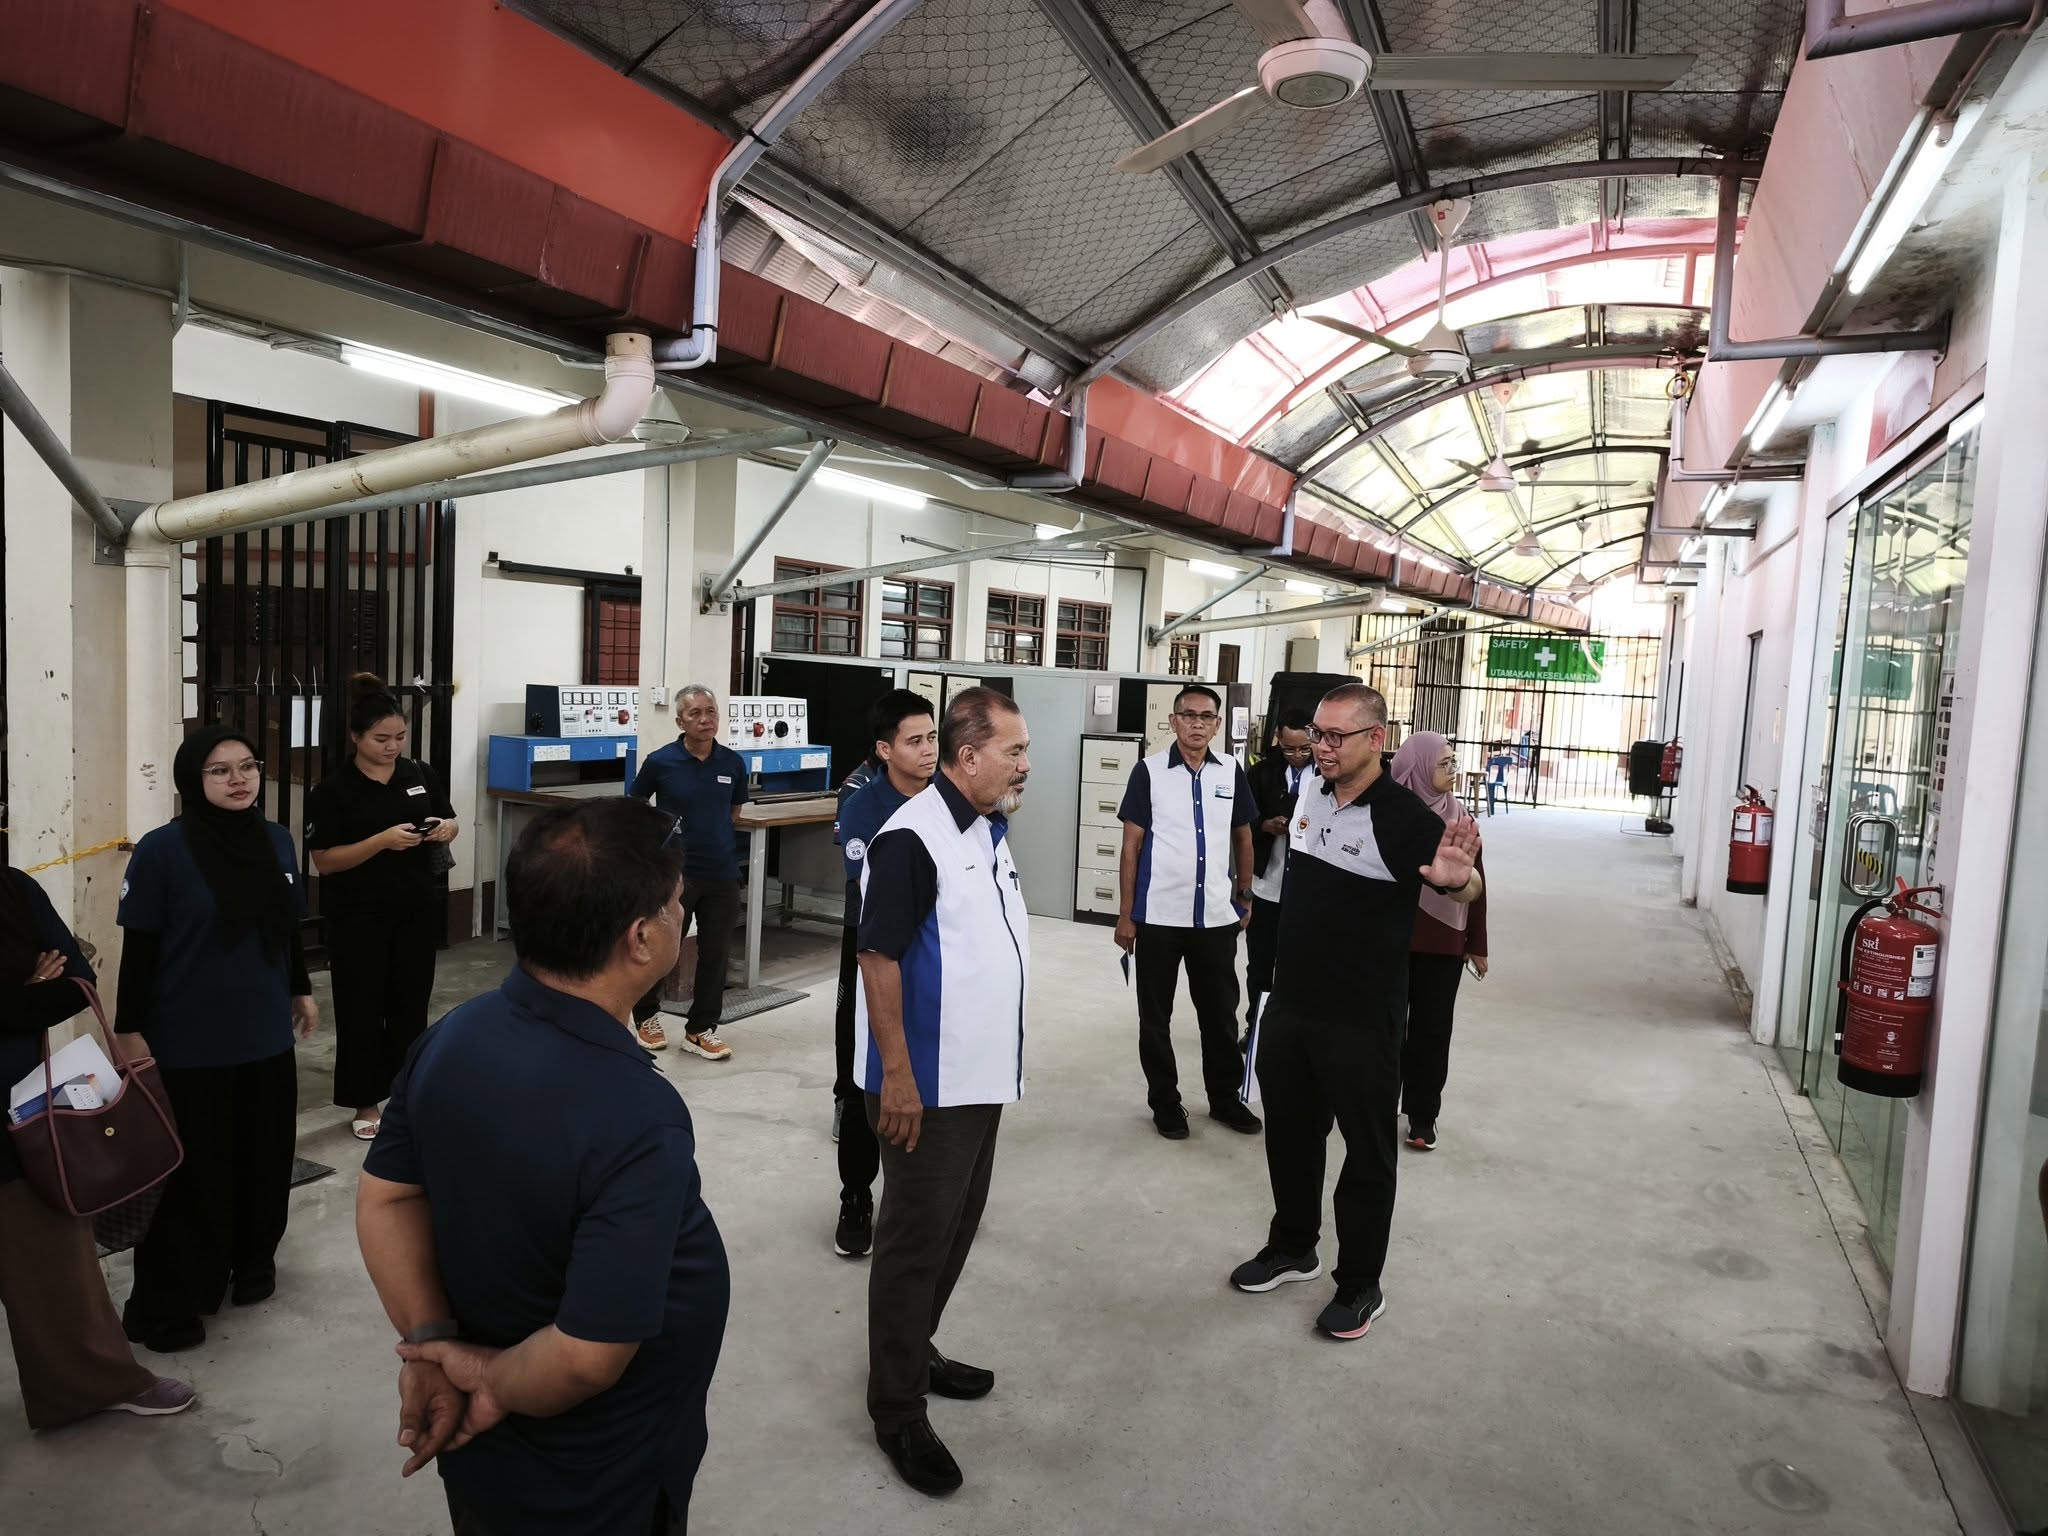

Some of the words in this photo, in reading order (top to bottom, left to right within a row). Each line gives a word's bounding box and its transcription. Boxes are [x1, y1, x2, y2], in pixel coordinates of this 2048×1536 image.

[1492, 639, 1530, 649] SAFETY
[1572, 642, 1601, 653] FIST
[1490, 668, 1536, 678] UTAMAKAN
